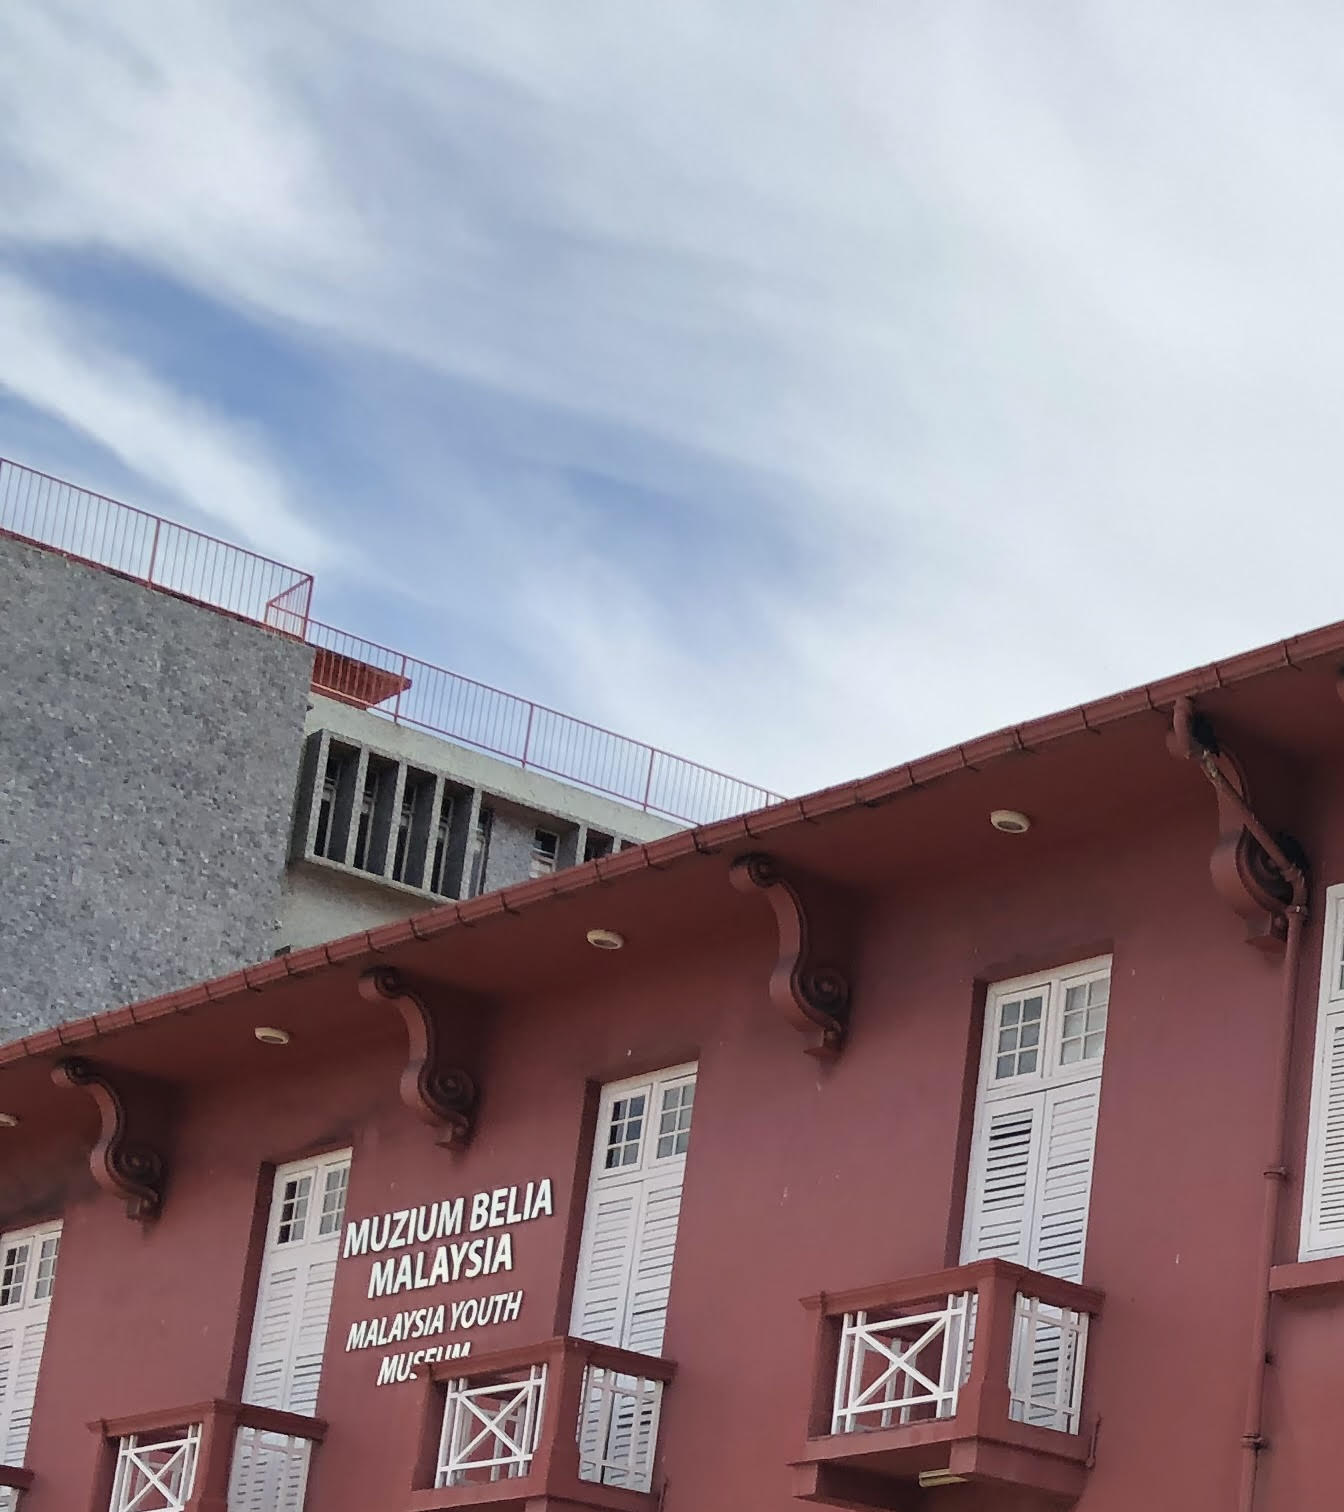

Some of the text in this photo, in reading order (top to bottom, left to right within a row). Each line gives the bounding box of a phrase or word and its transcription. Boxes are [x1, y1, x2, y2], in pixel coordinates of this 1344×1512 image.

[342, 1178, 553, 1259] MUZIUM BELIA
[367, 1232, 513, 1300] MALAYSIA
[345, 1290, 523, 1352] MALAYSIA YOUTH
